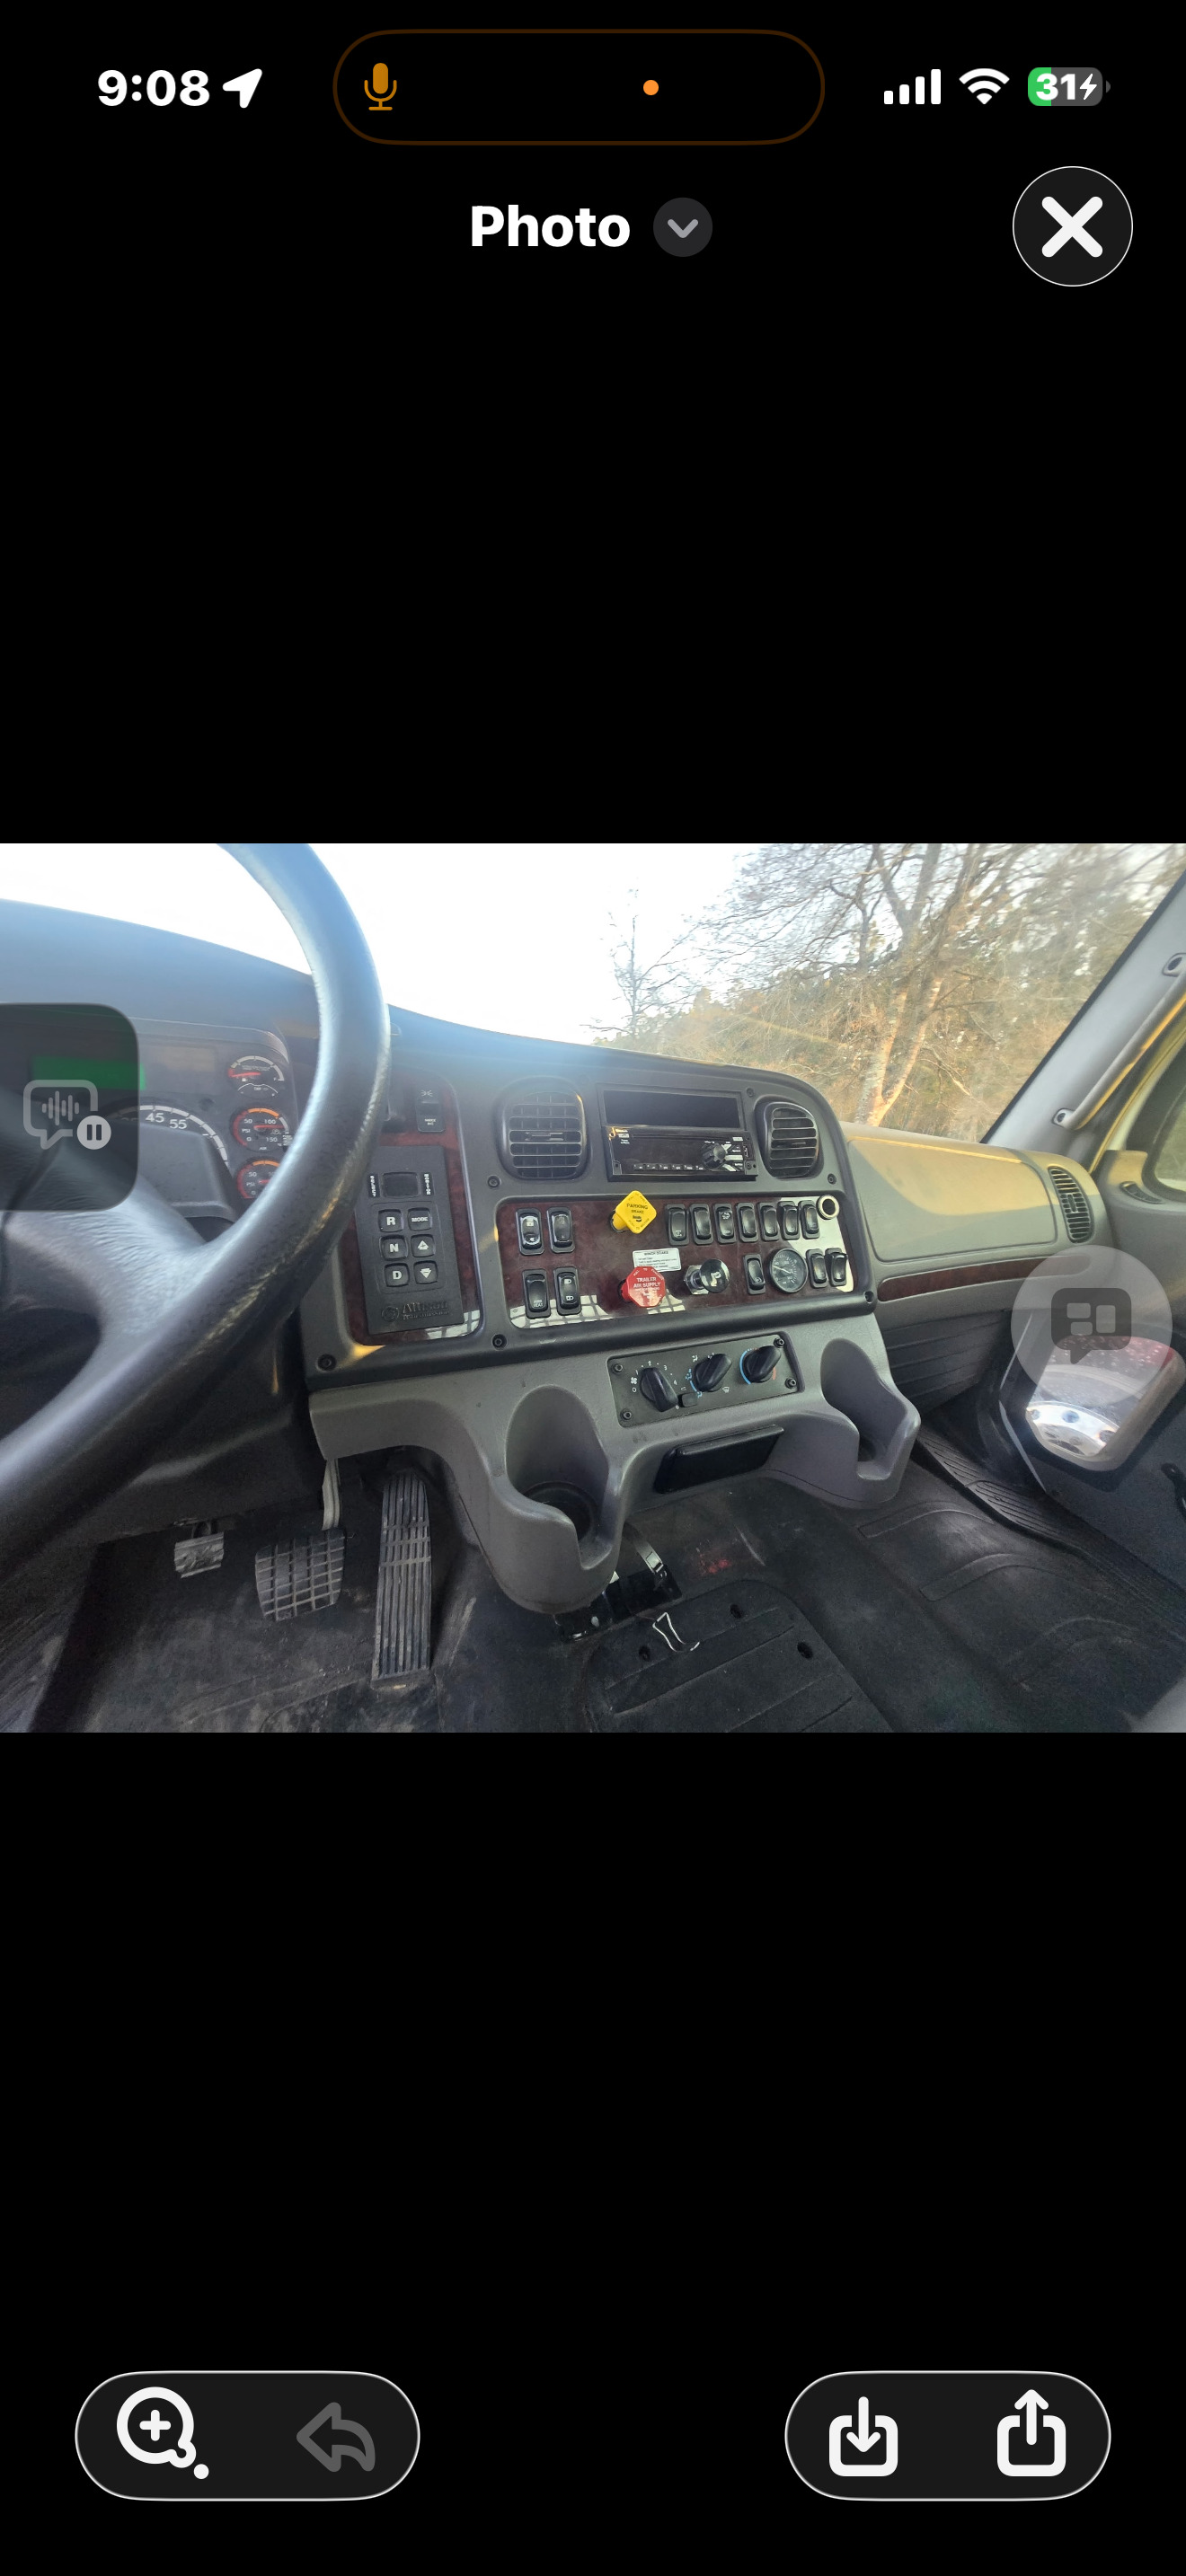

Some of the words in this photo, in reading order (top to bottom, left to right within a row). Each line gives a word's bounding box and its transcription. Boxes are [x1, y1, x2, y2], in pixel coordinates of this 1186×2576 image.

[146, 1113, 164, 1123] 45
[169, 1119, 187, 1130] 55
[386, 1216, 396, 1226] R
[389, 1243, 399, 1253] N
[392, 1270, 403, 1280] D
